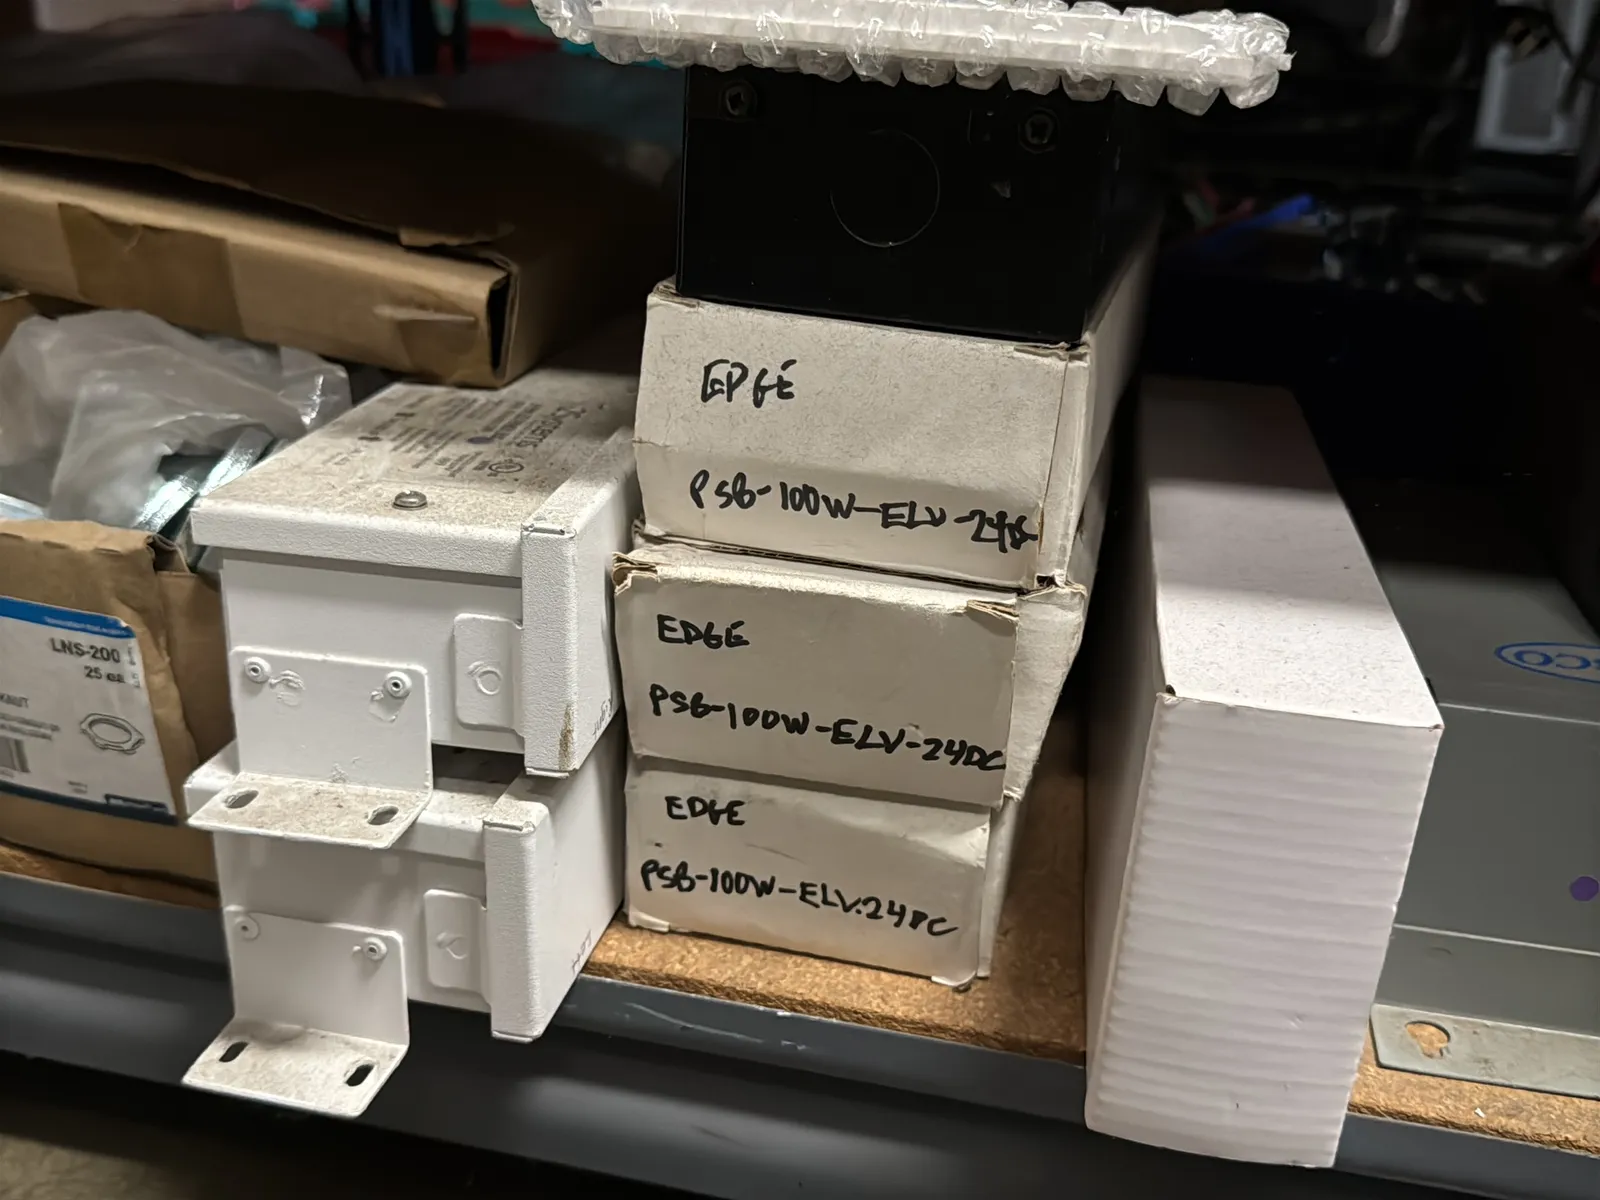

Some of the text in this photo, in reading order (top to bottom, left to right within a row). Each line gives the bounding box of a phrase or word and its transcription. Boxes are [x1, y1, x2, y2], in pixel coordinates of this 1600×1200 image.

[656, 614, 750, 649] EDGE
[50, 637, 121, 663] LNS-200
[83, 665, 103, 680] 25
[664, 796, 746, 826] EDGE
